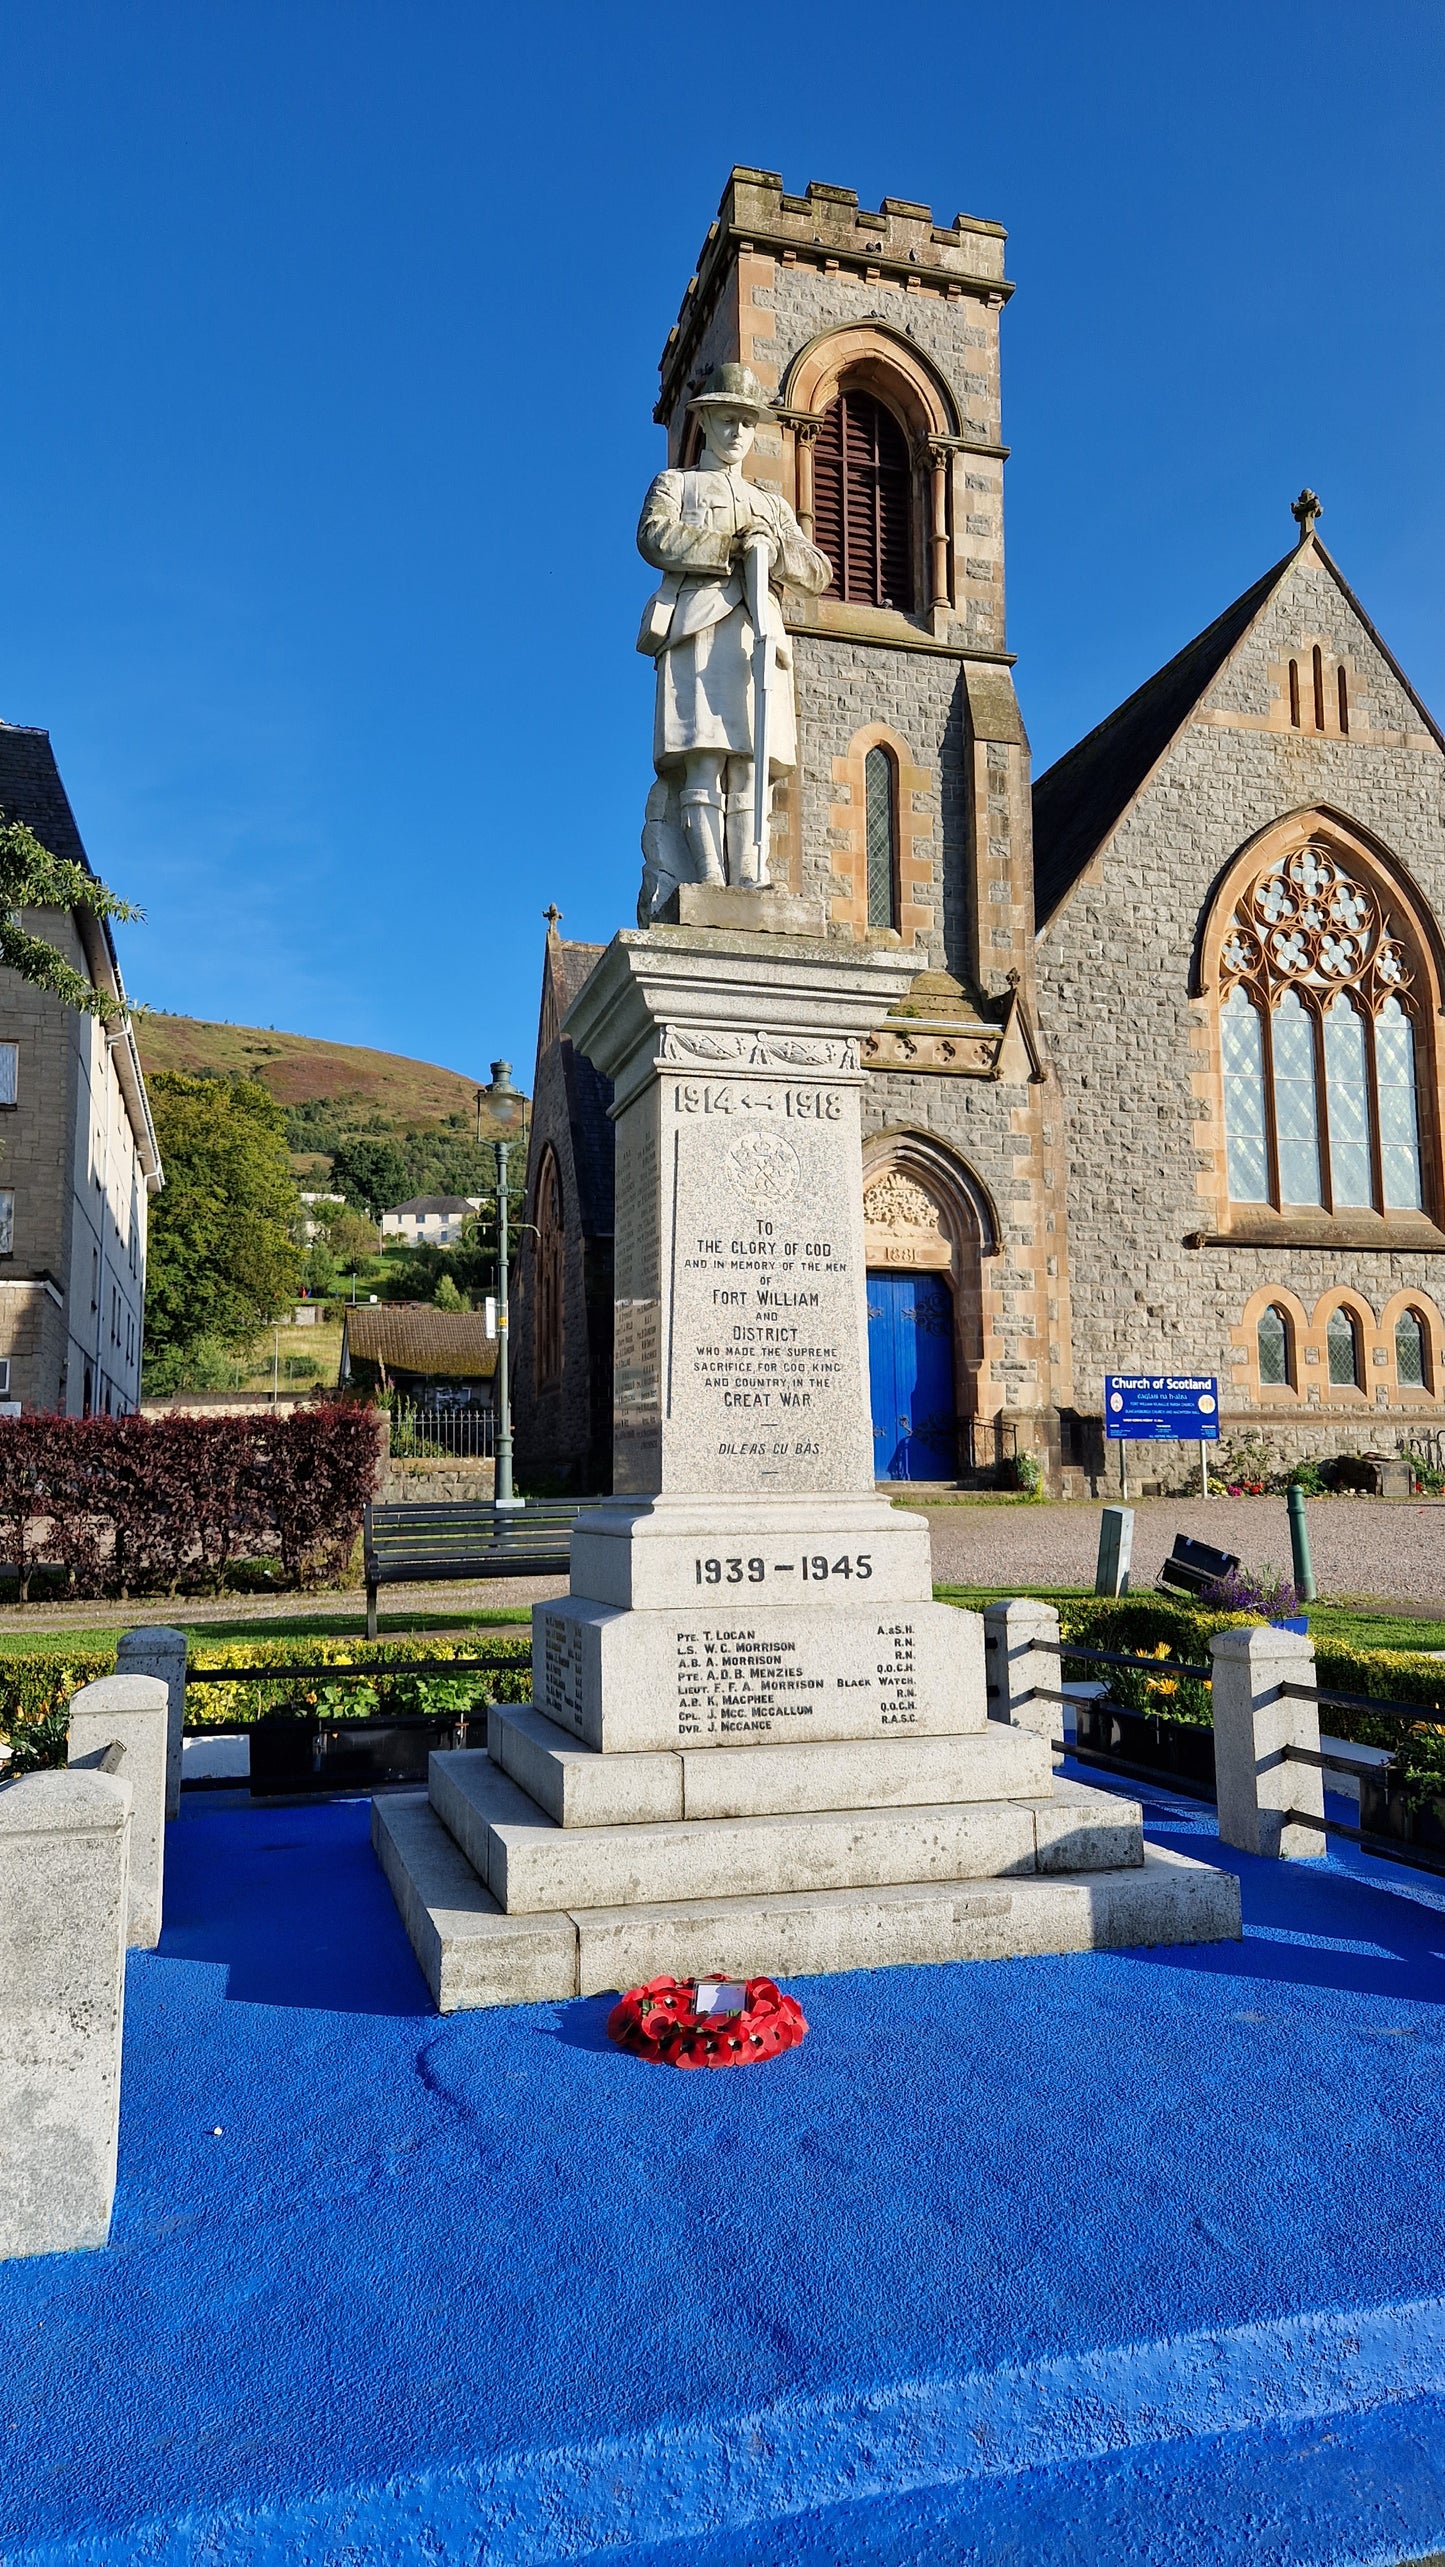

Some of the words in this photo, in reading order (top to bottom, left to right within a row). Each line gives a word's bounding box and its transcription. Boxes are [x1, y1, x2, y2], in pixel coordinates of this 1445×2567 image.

[756, 1220, 773, 1235] TO
[697, 1240, 722, 1253] THE
[731, 1240, 776, 1255] GLORY
[784, 1243, 799, 1256] OF
[805, 1243, 831, 1257] GOD
[684, 1259, 707, 1269] AND
[713, 1260, 725, 1269] IN
[730, 1260, 776, 1270] MEMORY
[782, 1262, 795, 1271] OF
[801, 1262, 821, 1272] THE
[825, 1262, 847, 1272] MEN
[759, 1276, 772, 1286] OF
[712, 1289, 747, 1305] FORT
[756, 1290, 819, 1306] WILLIAM
[756, 1312, 778, 1321] AND
[733, 1326, 798, 1341] DISTRICT
[696, 1346, 720, 1356] WHO
[726, 1347, 755, 1356] MADE
[761, 1347, 781, 1357] THE
[787, 1347, 838, 1357] SUPREME
[758, 1363, 777, 1372] FOR
[705, 1378, 729, 1387] AND
[792, 1379, 803, 1387] IN
[810, 1379, 830, 1388] THE
[1111, 1377, 1150, 1389] Church
[1152, 1377, 1164, 1389] of
[1167, 1378, 1212, 1390] Scotland
[724, 1391, 771, 1407] GREAT
[719, 1443, 766, 1455] DILEAS
[716, 1630, 755, 1641] LOGAN
[736, 1642, 796, 1653] MORRISON
[894, 1638, 915, 1647] R.N.
[722, 1655, 782, 1666] MORRISON
[895, 1650, 916, 1660] R.N.
[750, 1668, 803, 1679] MENZIES
[760, 1679, 824, 1691] MORRISON
[837, 1678, 872, 1688] BLACK
[896, 1689, 917, 1698] R.N.
